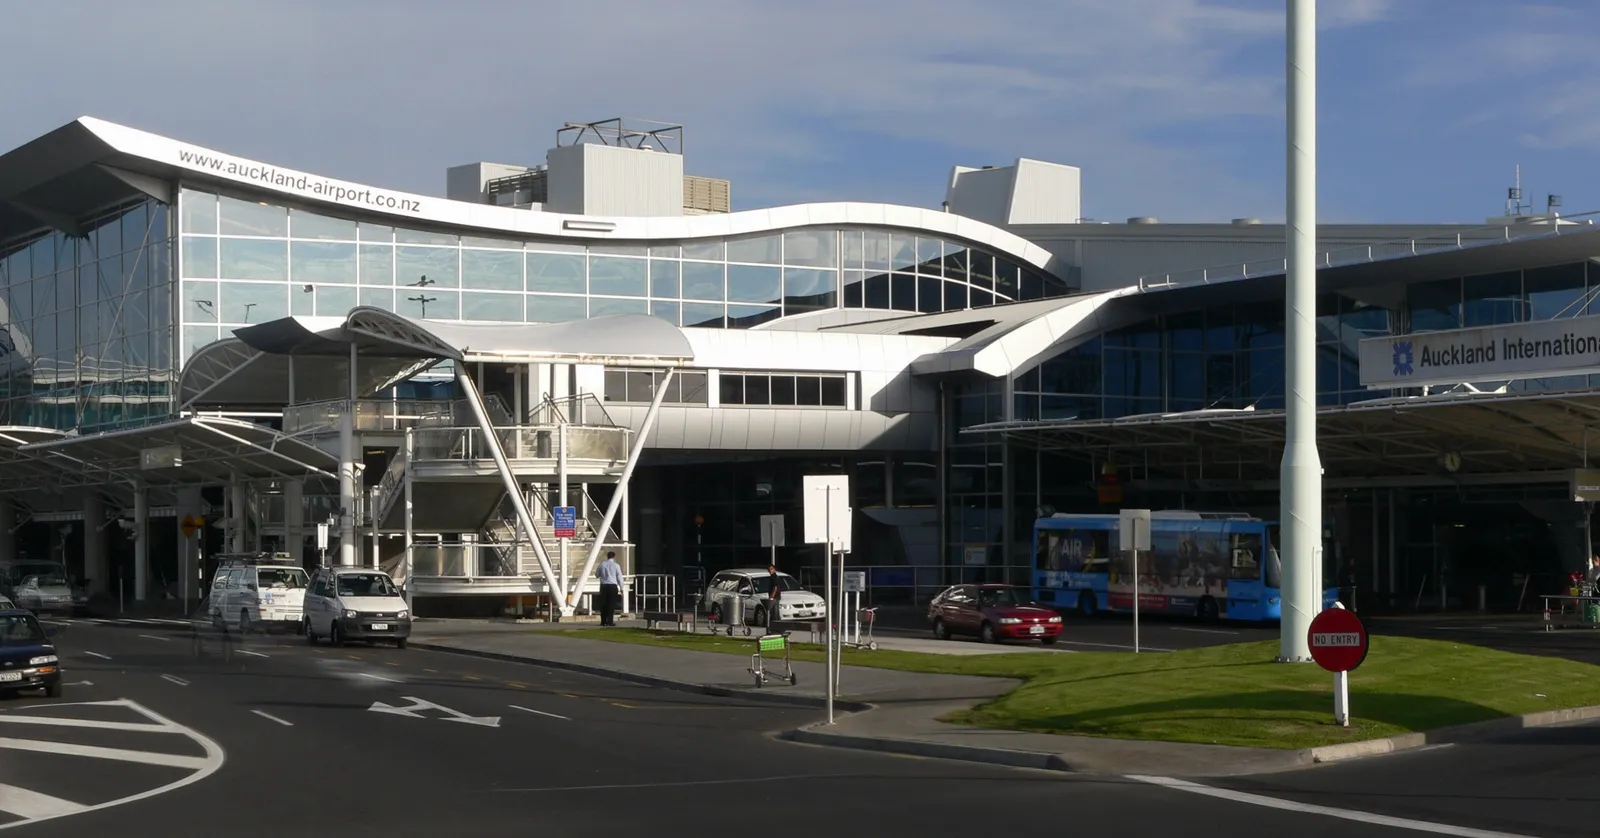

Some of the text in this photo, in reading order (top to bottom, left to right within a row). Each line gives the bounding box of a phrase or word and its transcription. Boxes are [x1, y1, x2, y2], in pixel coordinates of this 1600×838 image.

[179, 150, 421, 212] www.auckland-airport.co.nz
[1420, 341, 1495, 367] Auckland
[1061, 538, 1082, 557] AIR
[1315, 635, 1357, 644] NO ENTRY
